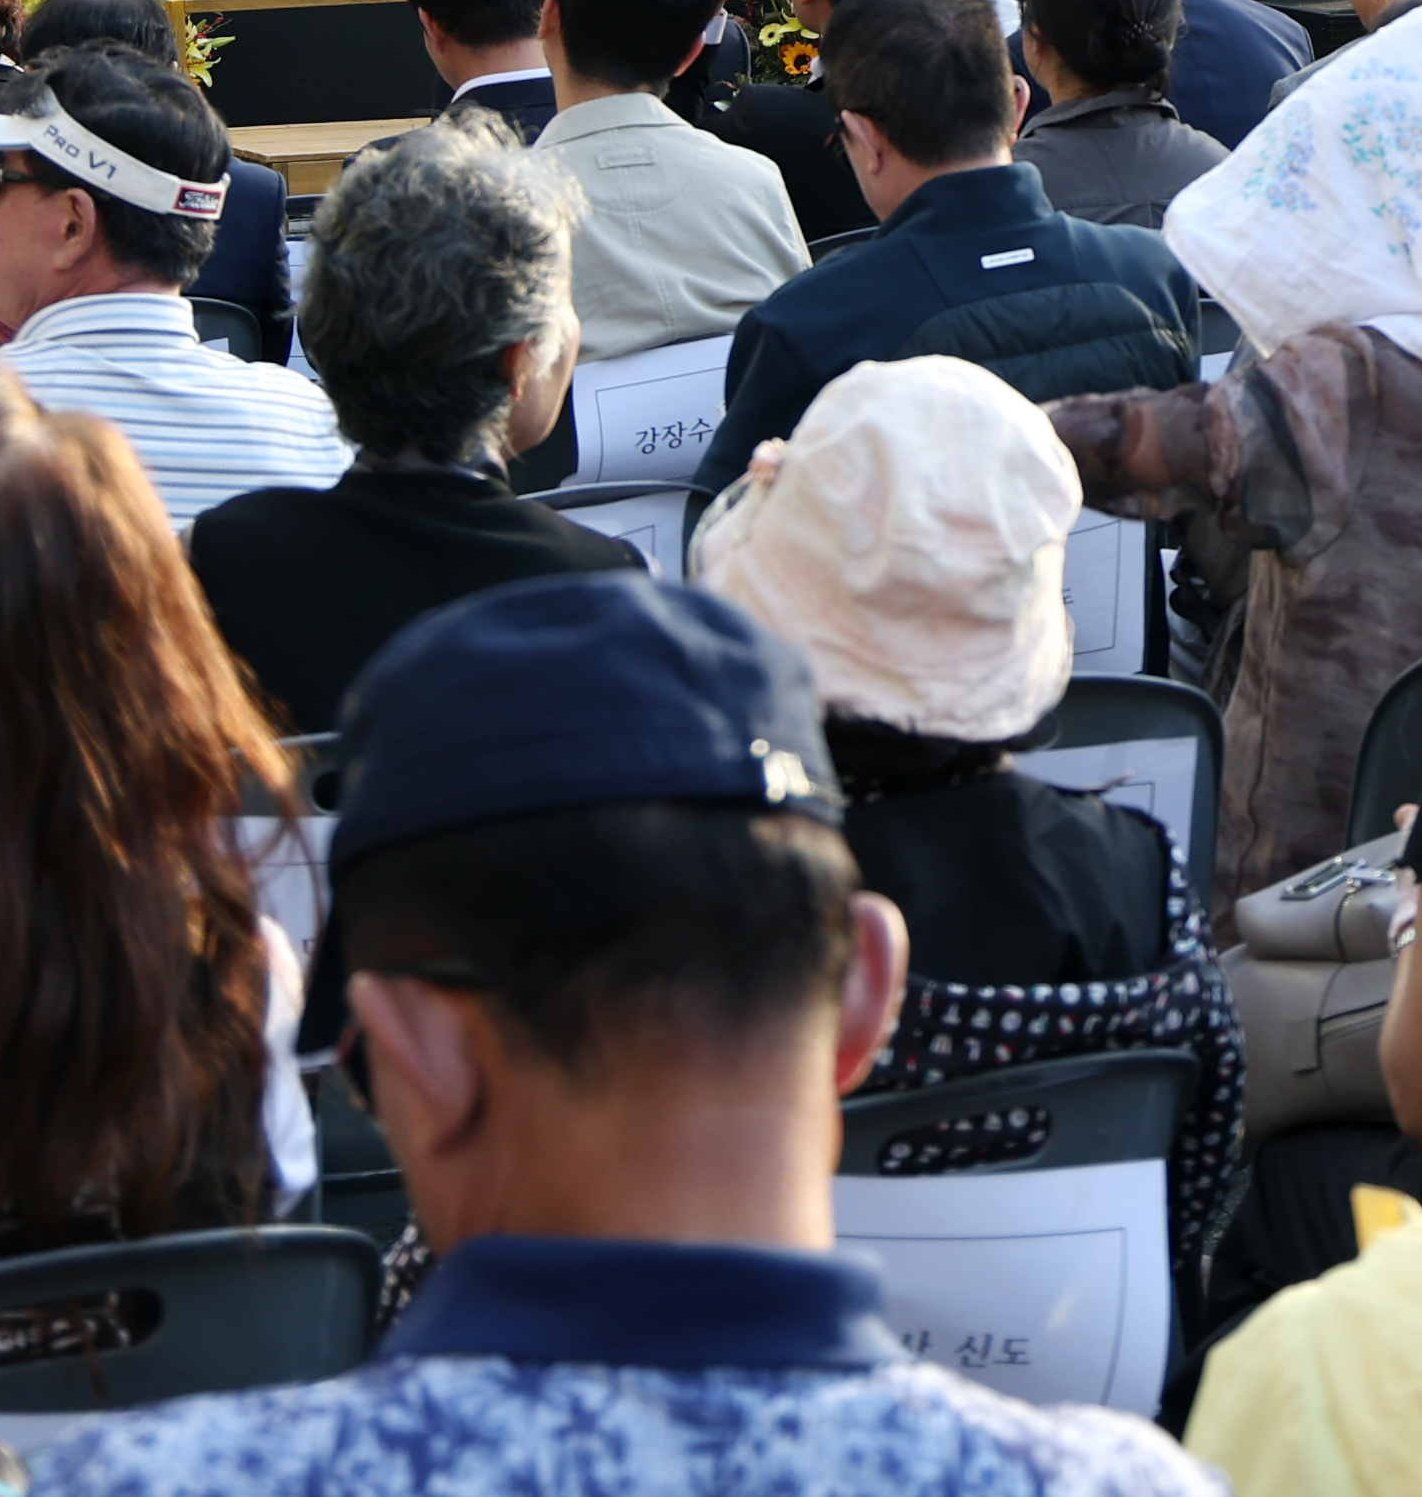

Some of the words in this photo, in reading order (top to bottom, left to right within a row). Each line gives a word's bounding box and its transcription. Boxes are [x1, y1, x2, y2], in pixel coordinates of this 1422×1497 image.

[89, 151, 117, 180] V1
[635, 418, 714, 455] 강장수
[953, 1333, 1032, 1369] 신도
